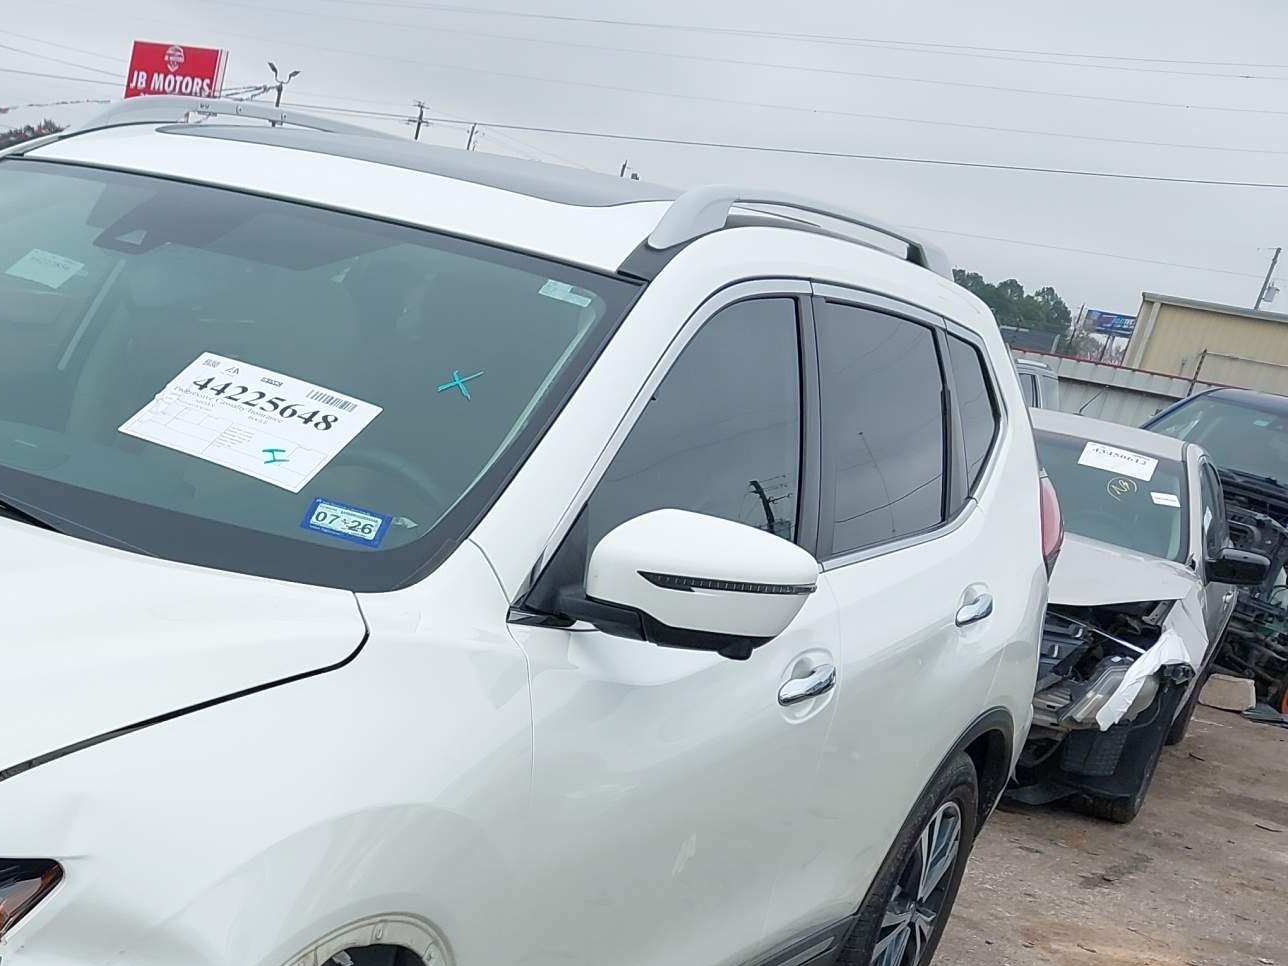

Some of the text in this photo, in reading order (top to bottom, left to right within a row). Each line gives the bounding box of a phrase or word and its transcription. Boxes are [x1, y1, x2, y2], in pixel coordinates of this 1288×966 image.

[130, 70, 211, 97] JB MOTORS
[193, 376, 339, 431] 44225648
